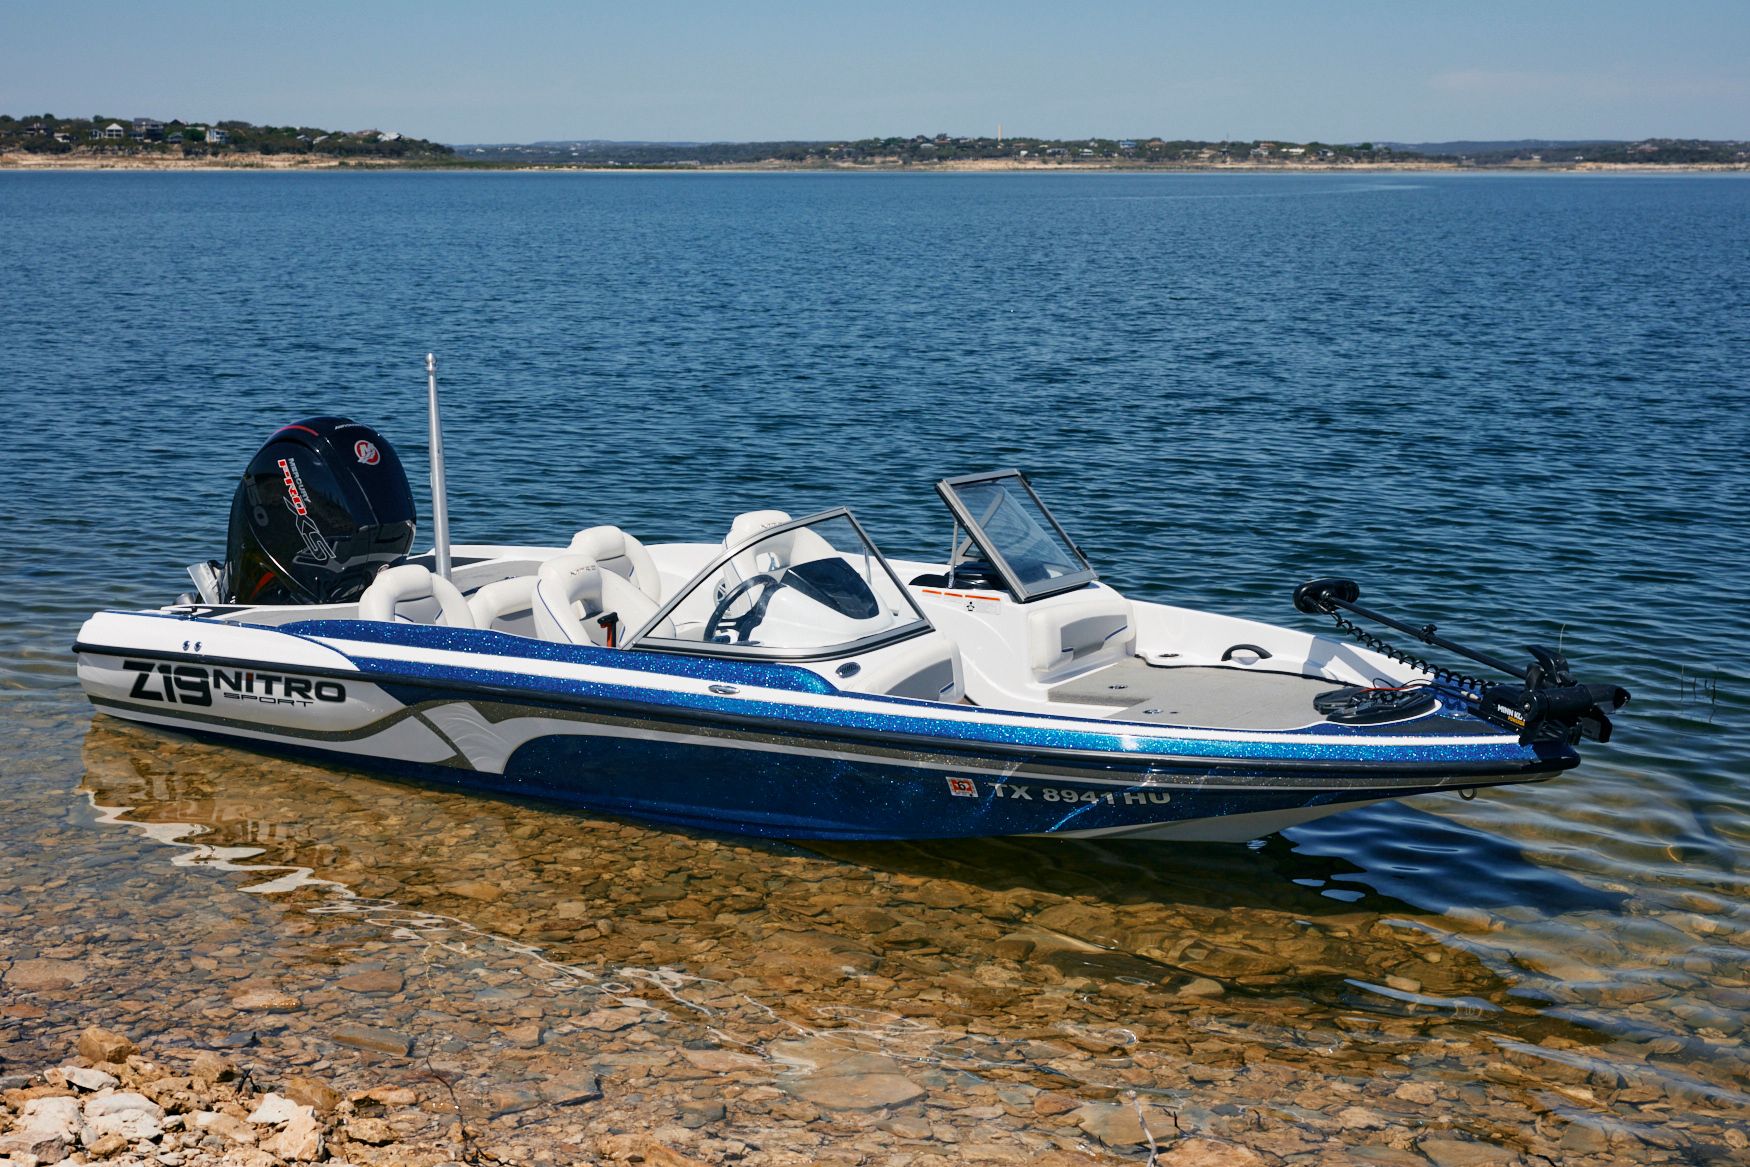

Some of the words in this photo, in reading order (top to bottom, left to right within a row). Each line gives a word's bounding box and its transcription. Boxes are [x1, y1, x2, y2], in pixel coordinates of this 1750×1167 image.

[288, 457, 312, 503] MERCURY
[122, 660, 213, 707] Z19
[213, 668, 347, 703] NITRO
[223, 691, 314, 708] SPORT
[987, 782, 1033, 800] TX
[1042, 788, 1115, 805] 8941
[1123, 792, 1171, 805] HU
